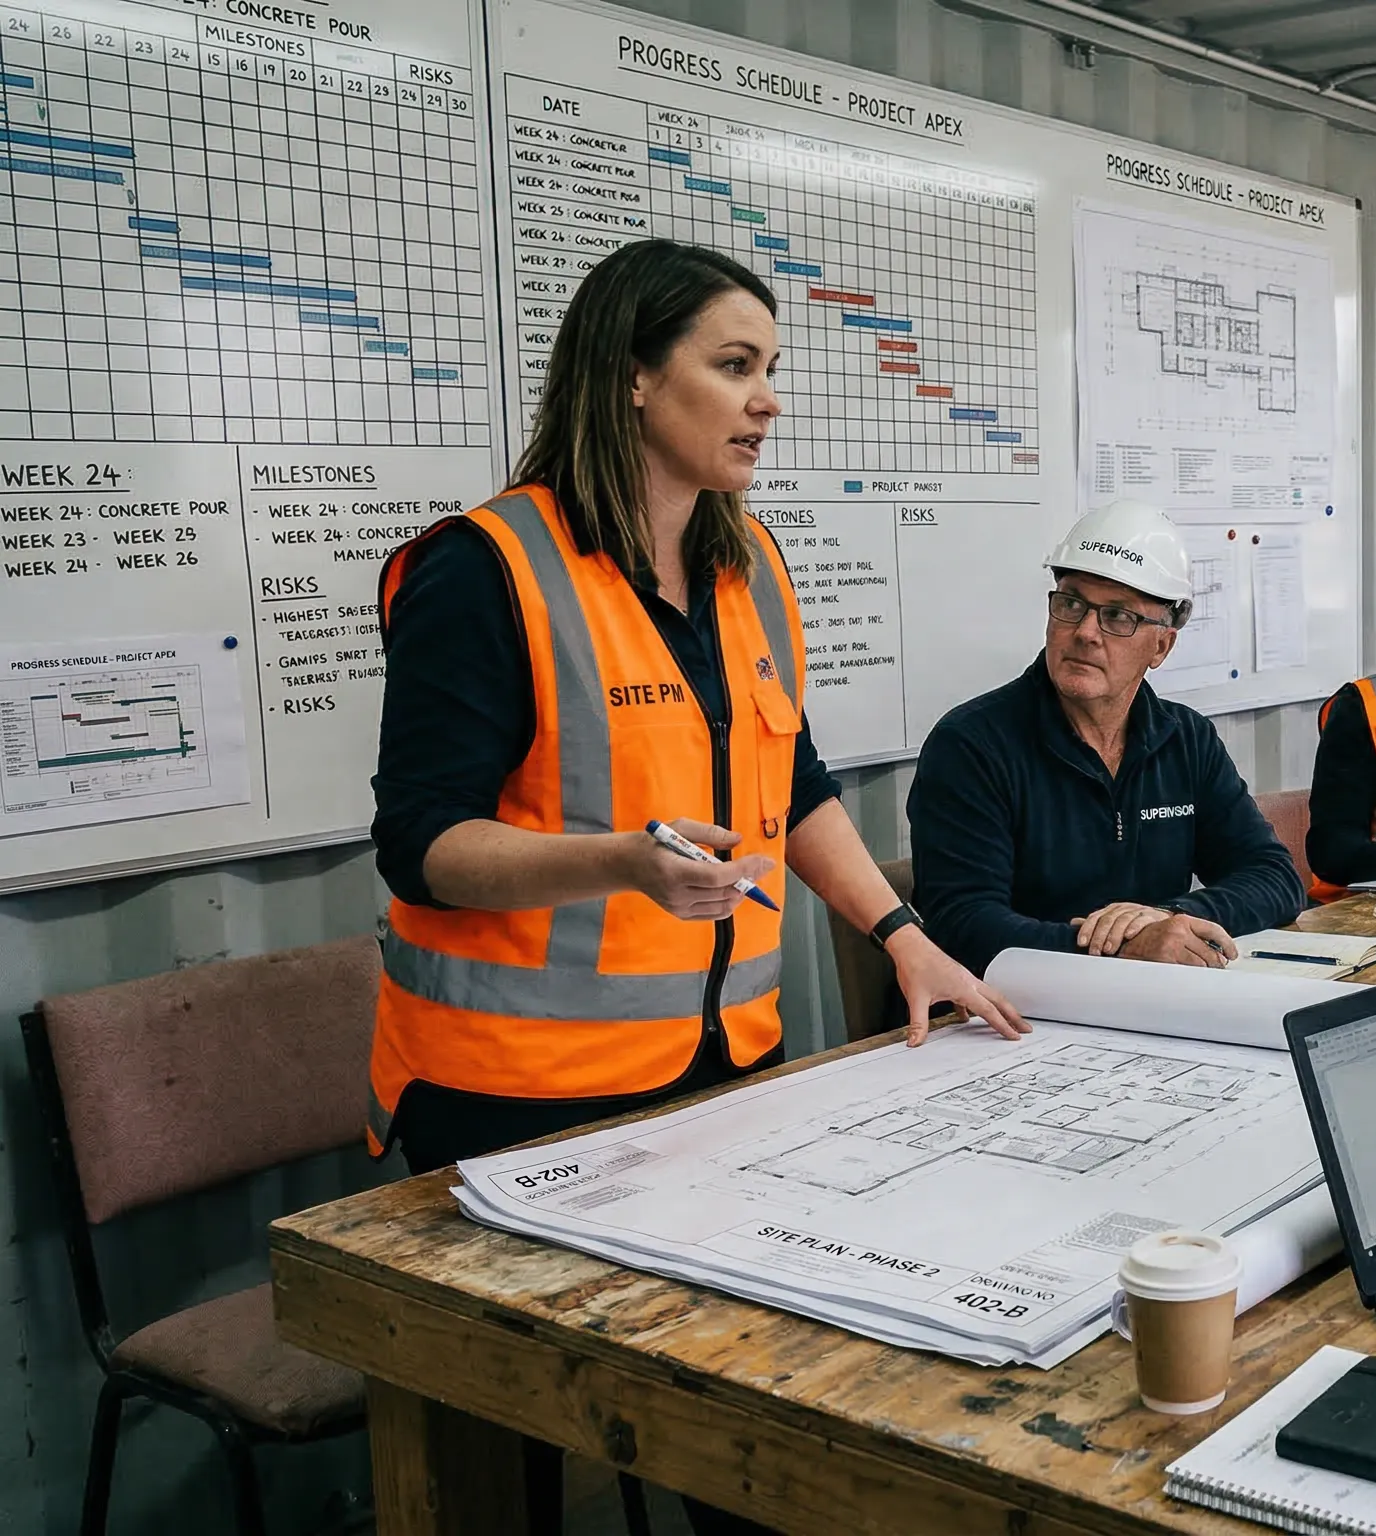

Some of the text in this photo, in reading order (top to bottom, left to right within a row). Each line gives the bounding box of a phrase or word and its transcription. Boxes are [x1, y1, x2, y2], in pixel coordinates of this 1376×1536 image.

[227, 0, 372, 41] CONCRETE POUR
[206, 25, 306, 56] MILESTONES
[9, 18, 30, 32] 24
[94, 34, 115, 47] 22
[135, 41, 153, 54] 23
[172, 48, 190, 61] 24
[236, 60, 248, 71] 16
[263, 65, 275, 76] 19
[290, 69, 306, 81] 20
[320, 75, 333, 87] 21
[347, 81, 363, 92] 22
[427, 95, 442, 107] 29
[452, 99, 466, 111] 30
[410, 65, 453, 85] RISKS
[618, 36, 722, 81] PROGRESS
[736, 66, 822, 104] SCHEDULE
[848, 91, 915, 126] PROJECT
[925, 113, 963, 137] APEX
[543, 96, 581, 117] DATE
[514, 125, 543, 138] WEEK
[655, 130, 659, 139] 1
[676, 134, 682, 144] 2
[696, 138, 703, 148] 3
[515, 150, 543, 163] WEEK
[517, 177, 545, 188] WEEK
[1107, 154, 1170, 186] PROGRESS
[1177, 172, 1232, 202] SCHEDULE
[1249, 189, 1293, 216] PROJECT
[1299, 203, 1324, 224] APEX
[523, 307, 552, 318] WEEK
[525, 333, 553, 344] WEEK
[1, 463, 74, 487] WEEK
[252, 465, 376, 485] MILESTONES
[767, 480, 799, 491] APPEX
[1, 506, 53, 522] WEEK
[98, 502, 181, 518] CONCRETE
[189, 501, 230, 515] POUR
[269, 504, 311, 518] WEEK
[352, 501, 421, 515] CONCRETE
[429, 500, 463, 513] POUR
[901, 507, 935, 522] RISKS
[2, 534, 55, 550] WEEK
[64, 532, 87, 547] 23
[113, 529, 165, 544] WEEK
[272, 529, 317, 544] WEEK
[357, 526, 428, 540] CONCRETE
[1079, 541, 1144, 566] SUPERVISOR
[5, 561, 56, 578] WEEK
[66, 559, 88, 573] 24
[117, 554, 168, 570] WEEK
[176, 551, 198, 566] 26
[261, 576, 318, 596] RISKS
[274, 607, 329, 624] HIGHEST
[284, 695, 336, 714] RISKS
[609, 683, 685, 707] SITE PM
[514, 1164, 579, 1188] 402-B
[757, 1226, 801, 1243] SITE
[797, 1237, 850, 1256] PLAN
[857, 1252, 926, 1274] PHASE
[923, 1267, 941, 1278] 2
[954, 1293, 1030, 1318] 402-B
